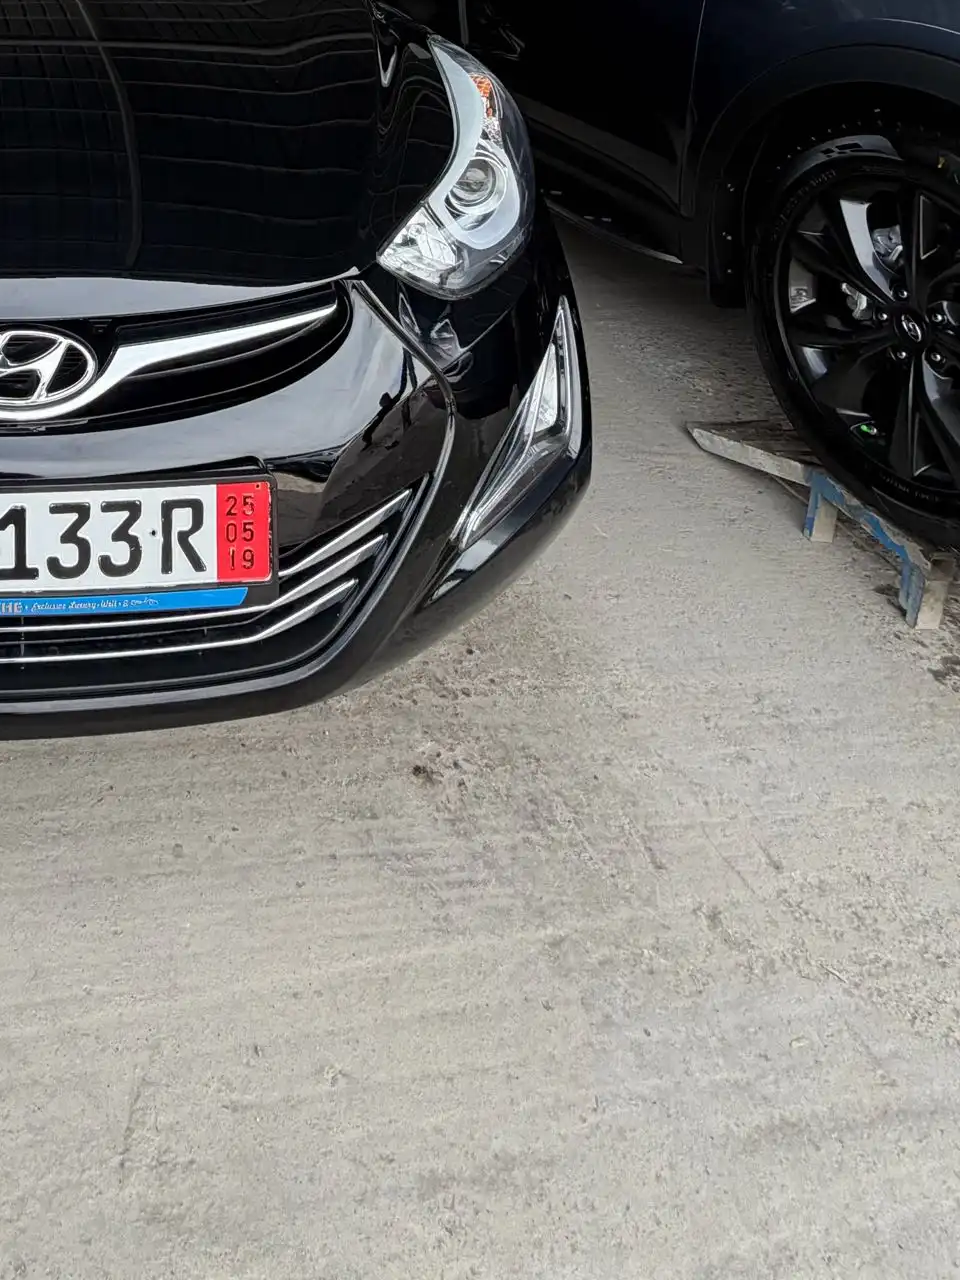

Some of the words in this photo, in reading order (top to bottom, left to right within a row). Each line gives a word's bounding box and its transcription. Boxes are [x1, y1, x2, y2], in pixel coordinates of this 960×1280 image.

[225, 495, 255, 516] 25
[225, 521, 255, 543] 05
[230, 548, 255, 570] 19
